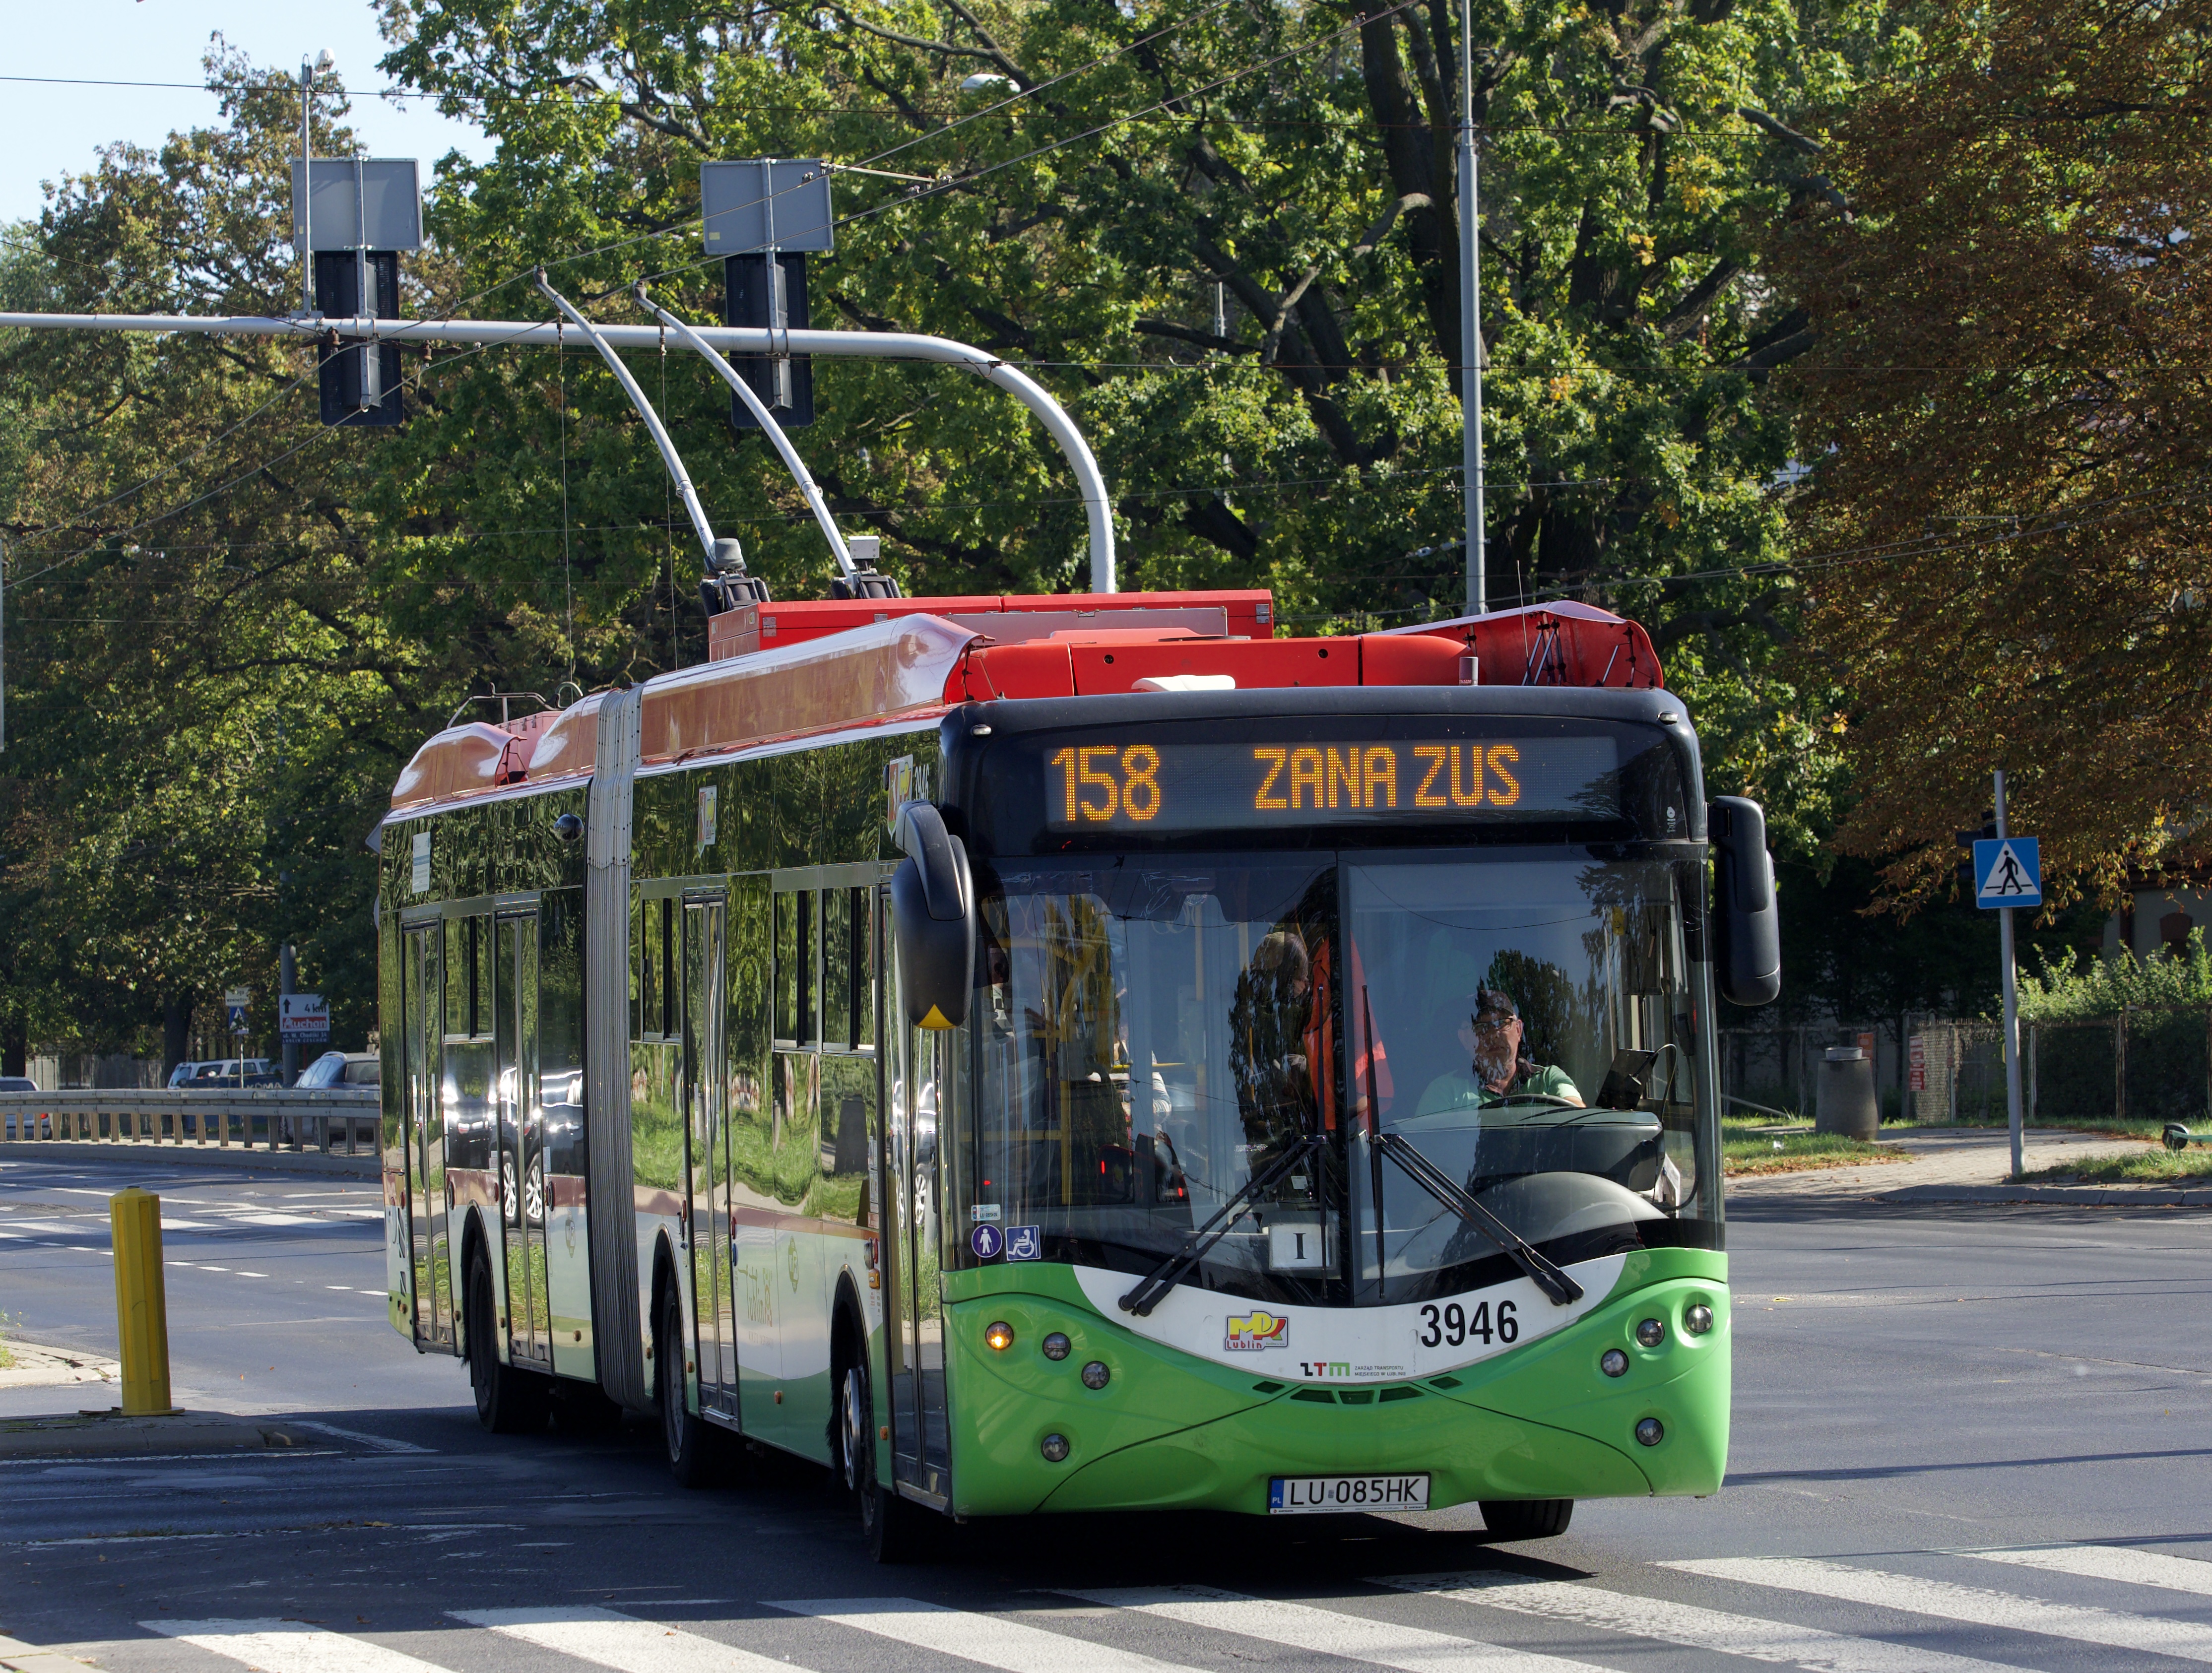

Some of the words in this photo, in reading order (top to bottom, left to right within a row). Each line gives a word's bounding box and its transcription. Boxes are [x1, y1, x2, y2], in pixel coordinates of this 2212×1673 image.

[915, 764, 929, 800] 3946
[1051, 744, 1160, 821] 158
[1253, 747, 1396, 809] ZANA
[1414, 745, 1519, 807] ZUS
[313, 1003, 326, 1013] km
[284, 1017, 326, 1029] Auchan
[1420, 1300, 1518, 1348] 3946
[1227, 1340, 1262, 1349] Lublin
[1300, 1362, 1350, 1376] ZTM
[1291, 1481, 1324, 1505] LU
[1336, 1479, 1420, 1504] 085HK
